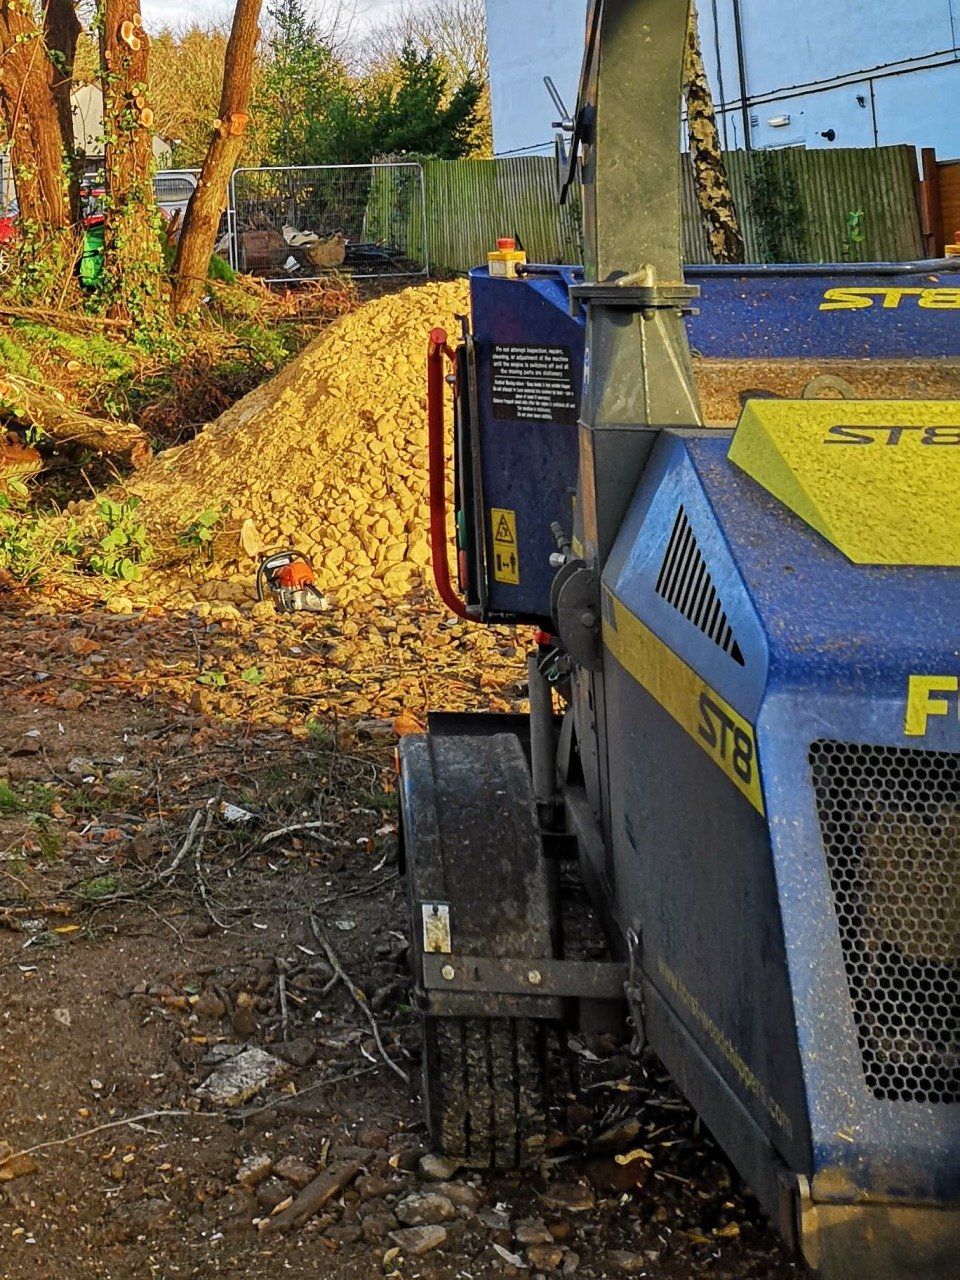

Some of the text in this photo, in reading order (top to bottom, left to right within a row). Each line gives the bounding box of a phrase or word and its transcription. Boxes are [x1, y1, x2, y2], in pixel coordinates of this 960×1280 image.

[819, 287, 960, 310] ST8
[823, 425, 960, 446] ST8
[698, 692, 753, 784] ST8
